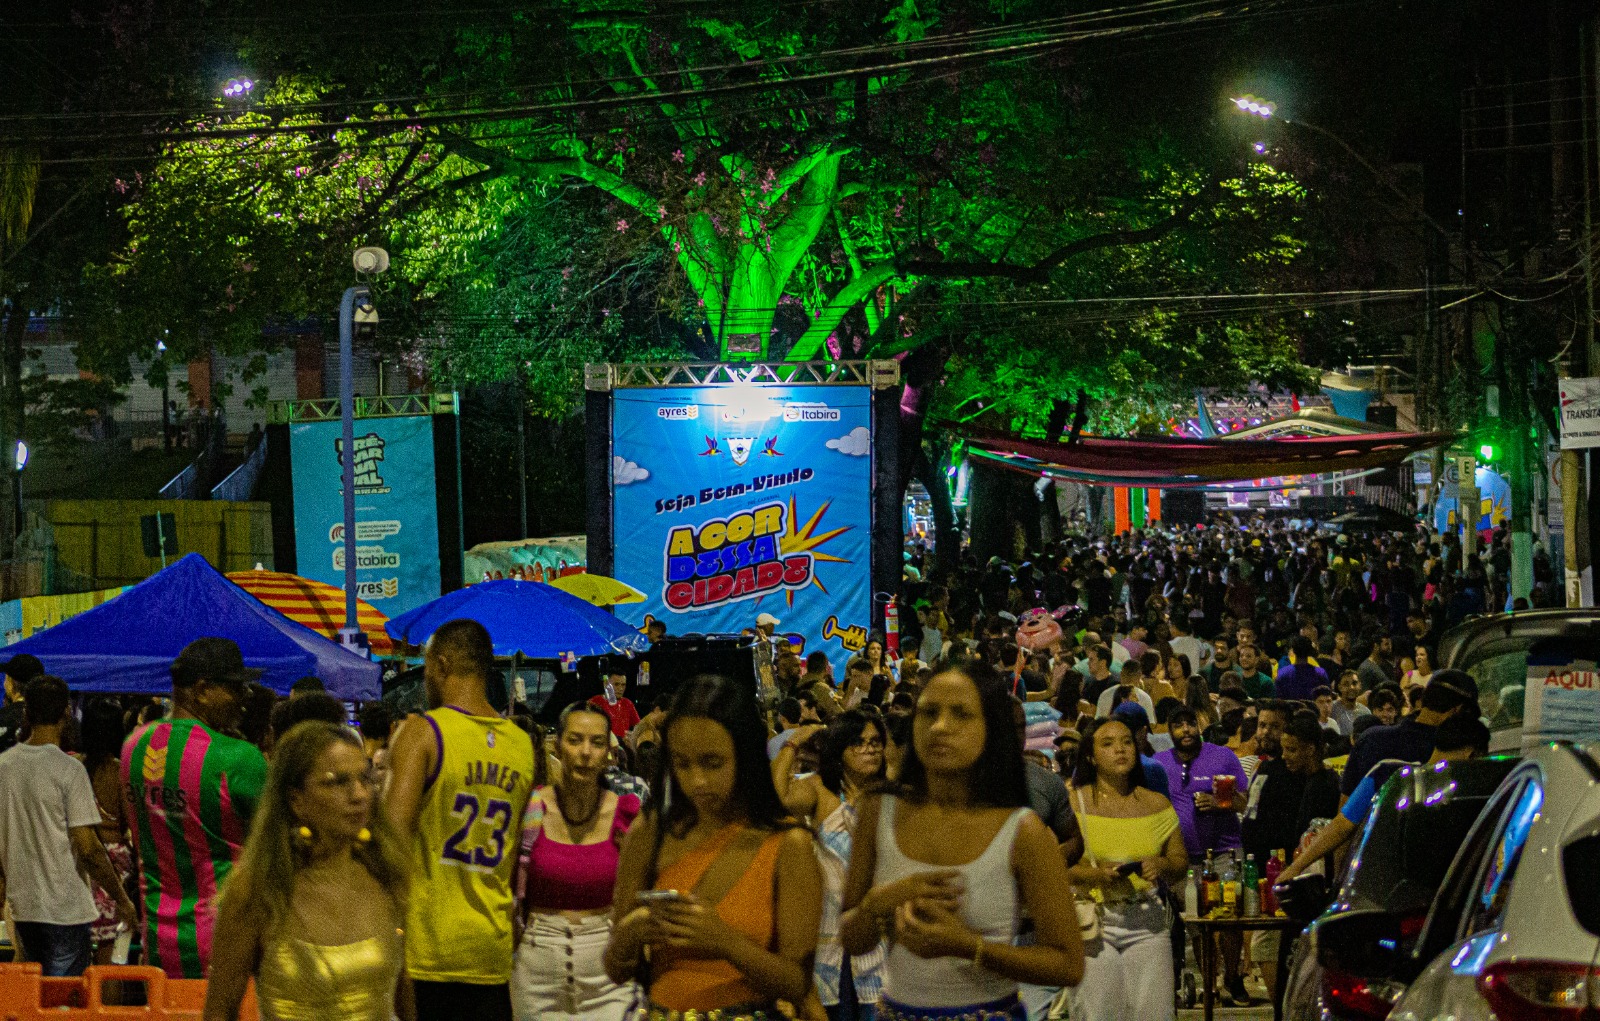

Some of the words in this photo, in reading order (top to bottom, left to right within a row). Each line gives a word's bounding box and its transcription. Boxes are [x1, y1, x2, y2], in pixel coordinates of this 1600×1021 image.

[658, 407, 687, 419] ayres
[802, 409, 838, 420] Itabira
[340, 448, 383, 464] AR
[1463, 461, 1470, 475] E
[344, 472, 382, 486] AL
[655, 494, 696, 514] Seja
[699, 468, 814, 504] Bem-Vindo
[669, 528, 695, 556] A
[699, 505, 783, 550] COR
[356, 555, 397, 567] tabira
[668, 535, 776, 582] DESSA
[667, 556, 809, 608] CIDADE
[1544, 670, 1593, 691] AQUI
[465, 760, 521, 793] JAMES
[441, 792, 512, 870] 23
